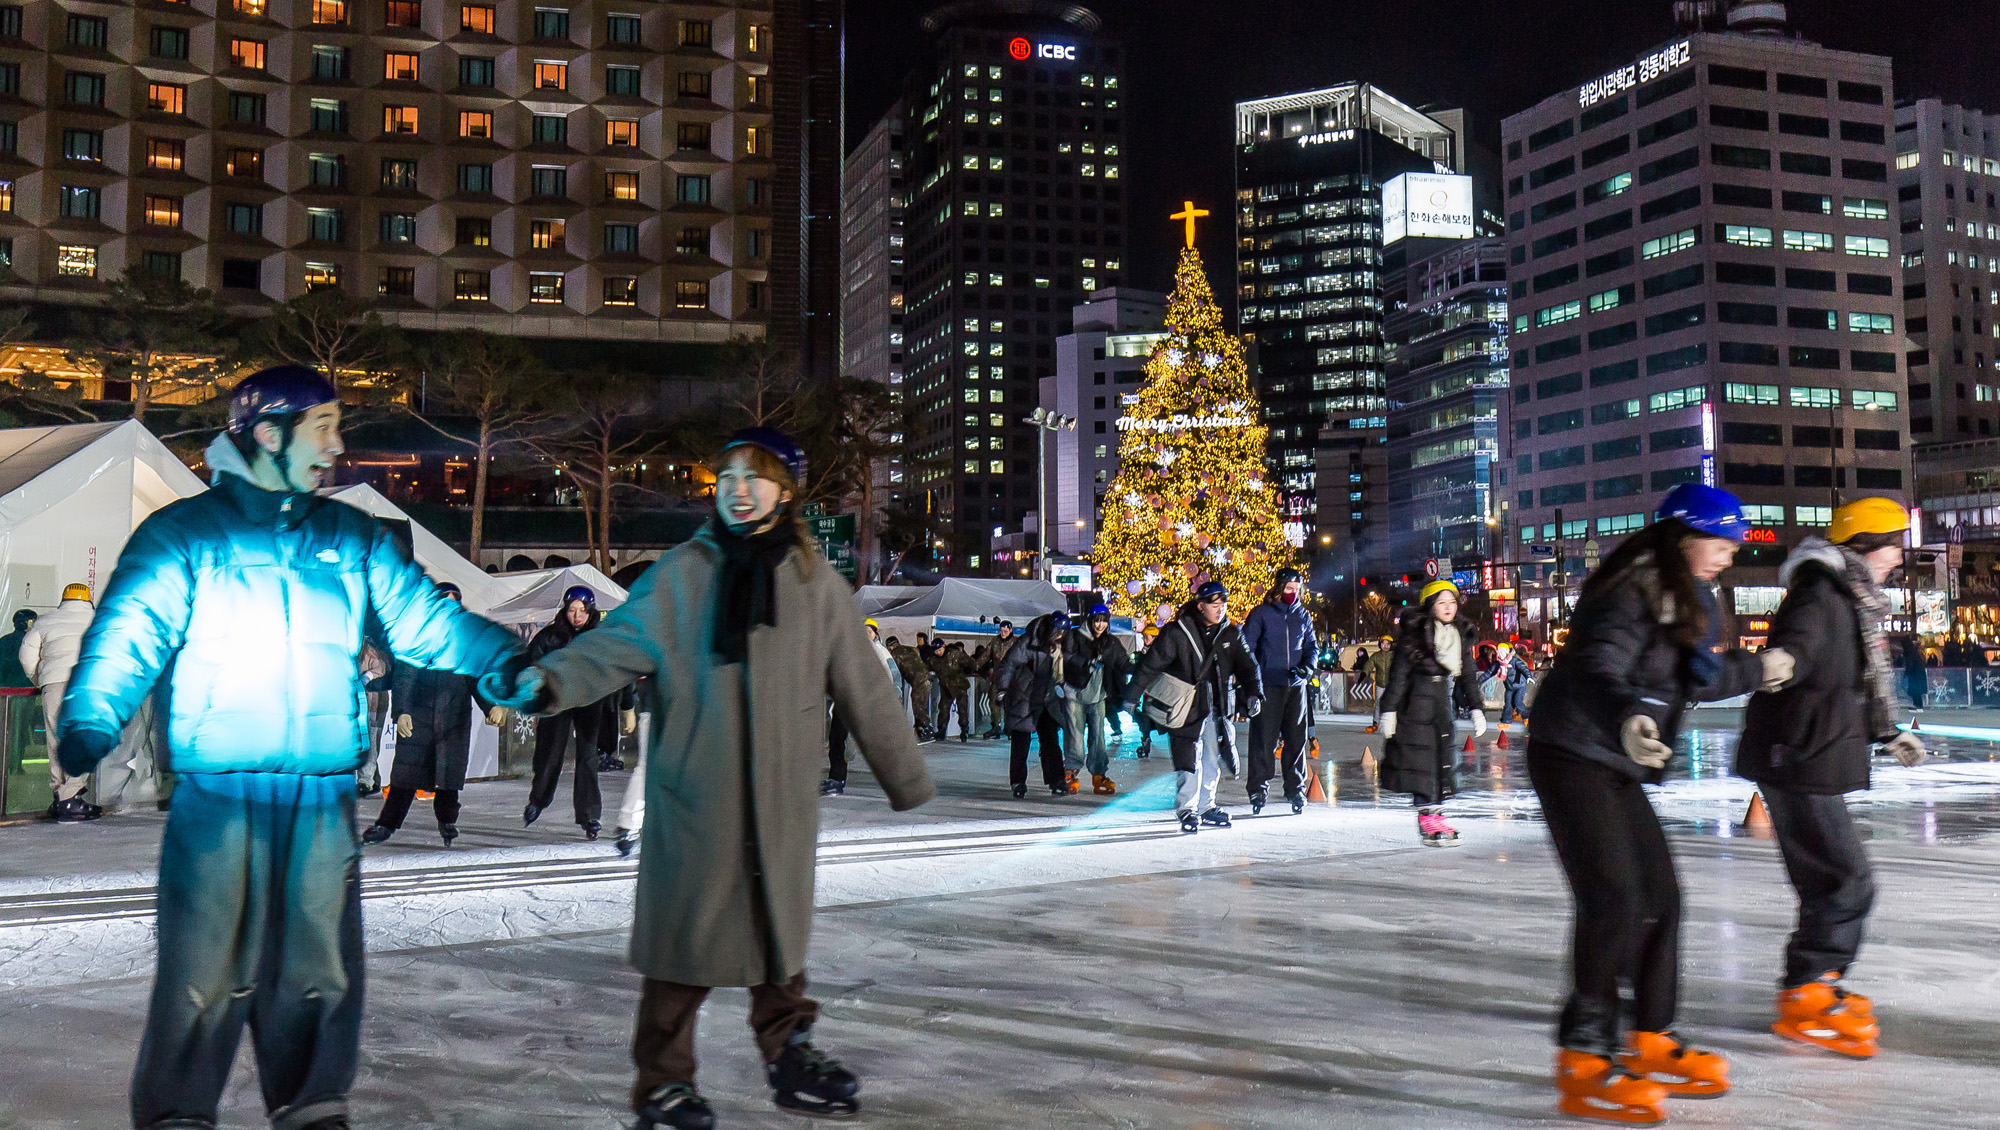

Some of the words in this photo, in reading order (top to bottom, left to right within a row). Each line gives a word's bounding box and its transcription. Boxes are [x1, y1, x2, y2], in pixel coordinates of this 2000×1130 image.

[1038, 43, 1075, 60] ICBC
[1579, 65, 1636, 108] 취업사관학교
[1639, 40, 1690, 83] 경동대학교
[1410, 212, 1471, 226] 한화손해보험
[1115, 416, 1168, 433] Merry
[1169, 412, 1251, 429] Christmas
[1742, 529, 1776, 542] 다이소
